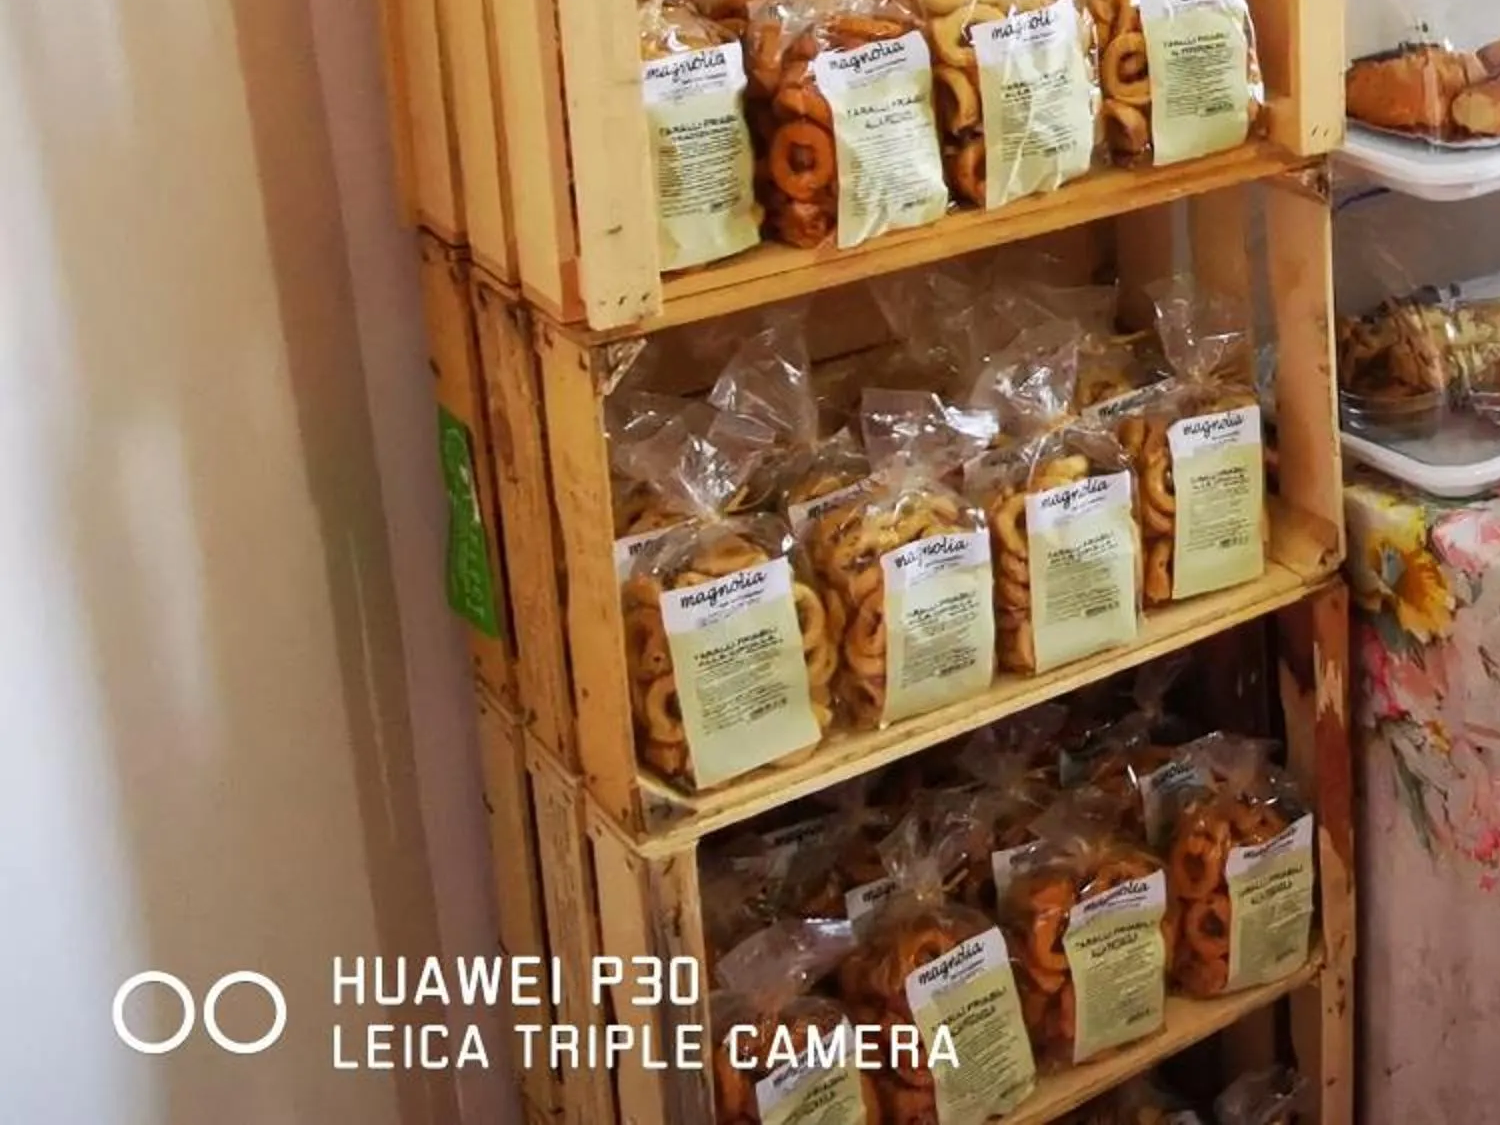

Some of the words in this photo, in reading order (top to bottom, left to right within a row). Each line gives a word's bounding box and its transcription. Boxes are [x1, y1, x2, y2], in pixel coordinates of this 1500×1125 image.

[829, 42, 904, 73] magnolia
[680, 570, 768, 609] magnolia
[918, 941, 985, 982] magnolia
